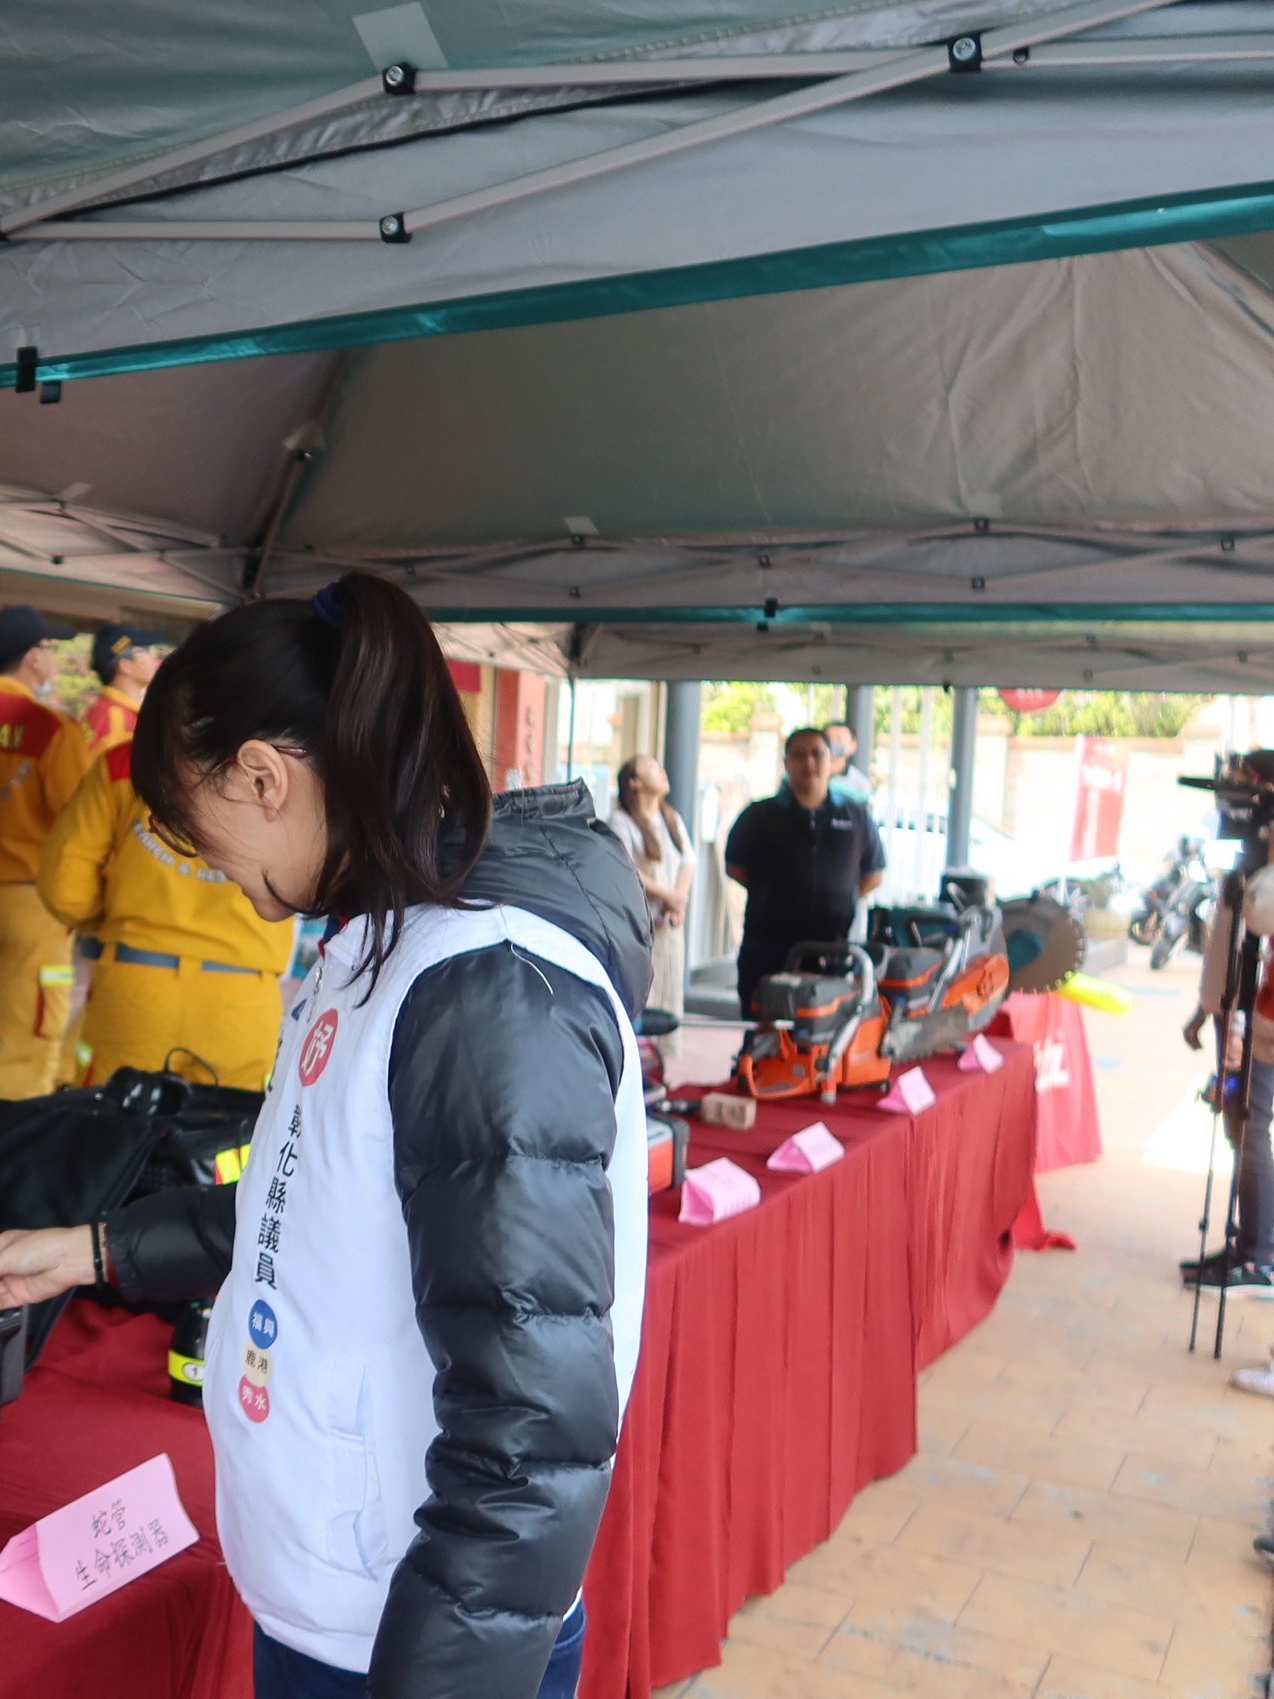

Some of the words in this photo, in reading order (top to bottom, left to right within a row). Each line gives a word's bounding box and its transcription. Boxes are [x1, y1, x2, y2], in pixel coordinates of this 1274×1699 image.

[255, 1104, 303, 1290] 彰化縣議員
[252, 1312, 276, 1338] 福興
[245, 1349, 269, 1375] 鹿港
[242, 1385, 267, 1411] 秀水
[91, 1498, 127, 1539] 蛇管
[75, 1518, 170, 1591] 生命探測器
